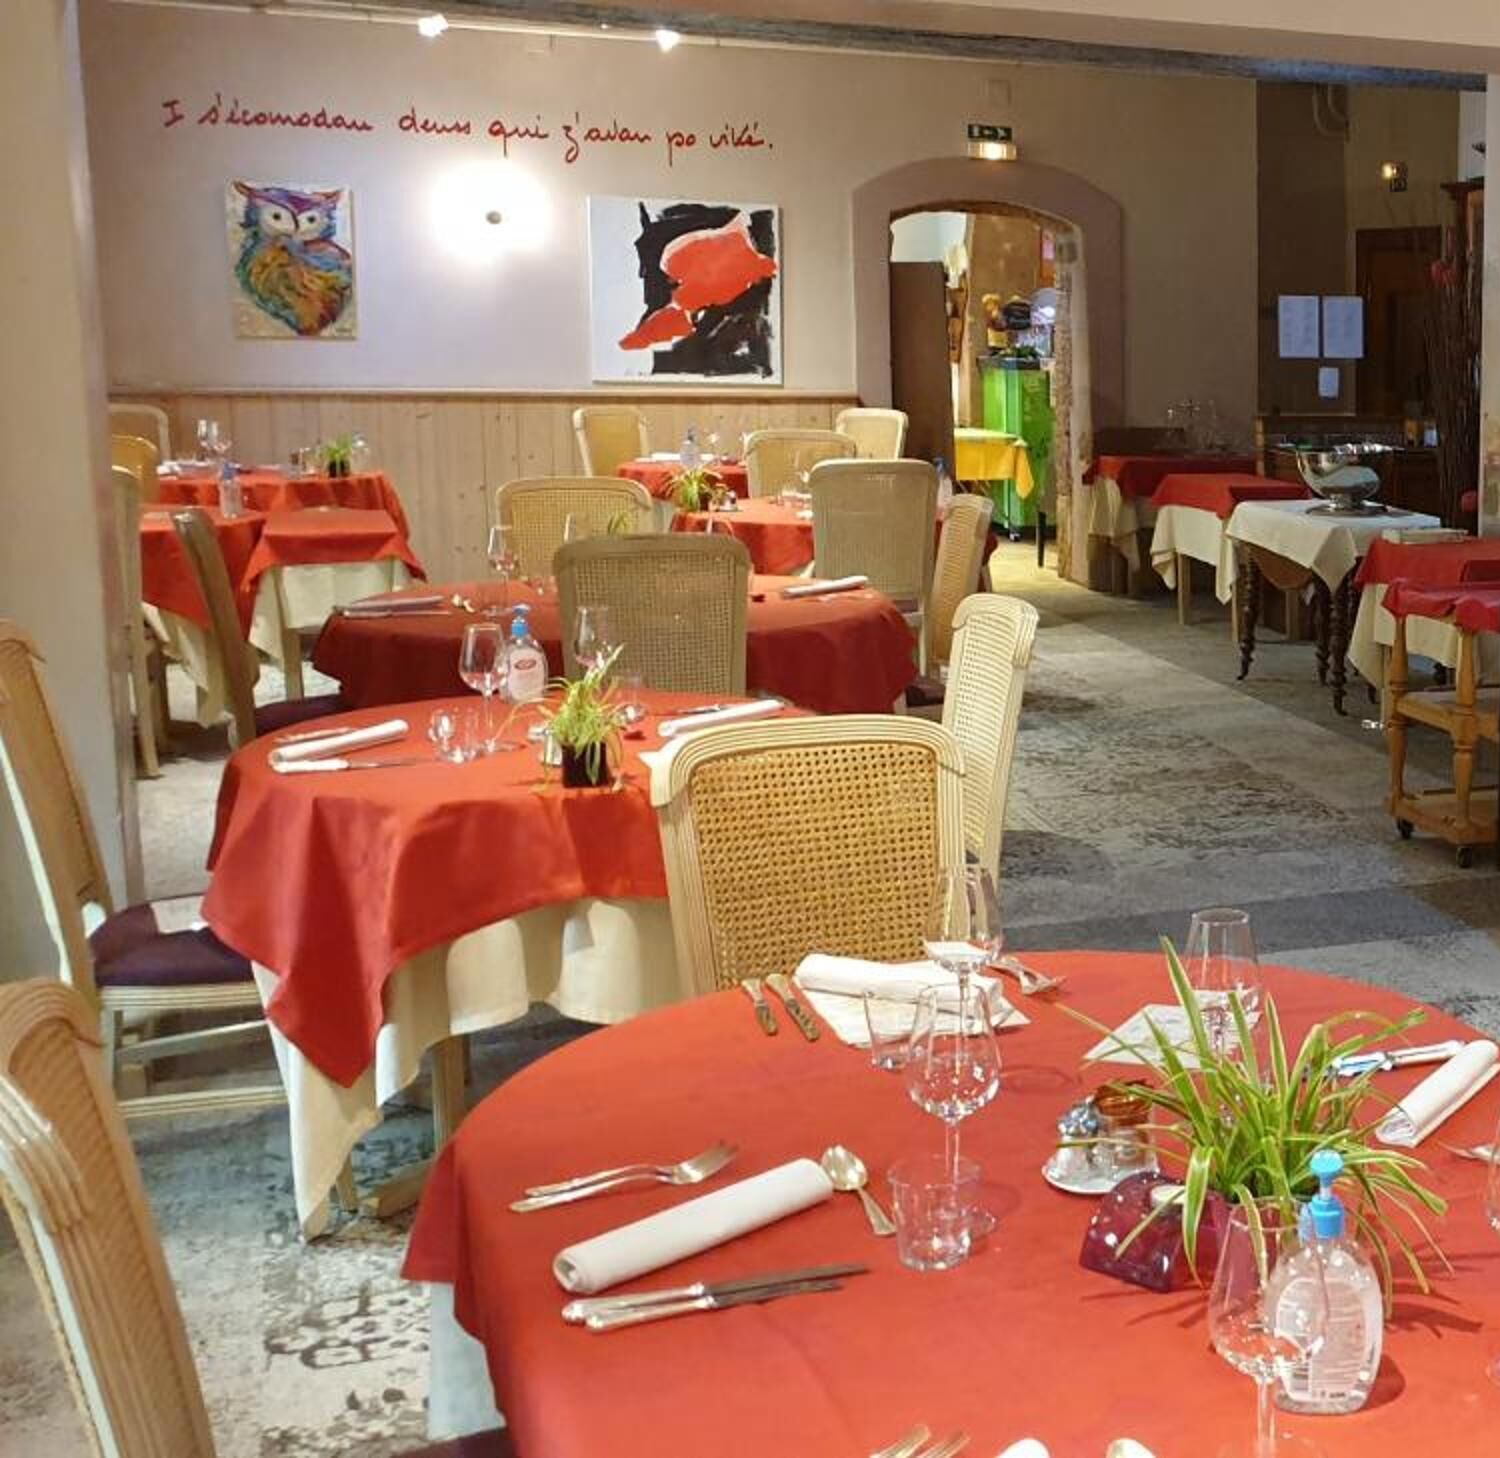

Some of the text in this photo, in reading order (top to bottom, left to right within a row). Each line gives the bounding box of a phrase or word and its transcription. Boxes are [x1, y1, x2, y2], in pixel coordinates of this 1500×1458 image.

[162, 99, 184, 127] I
[488, 115, 549, 158] qui
[666, 131, 697, 167] po
